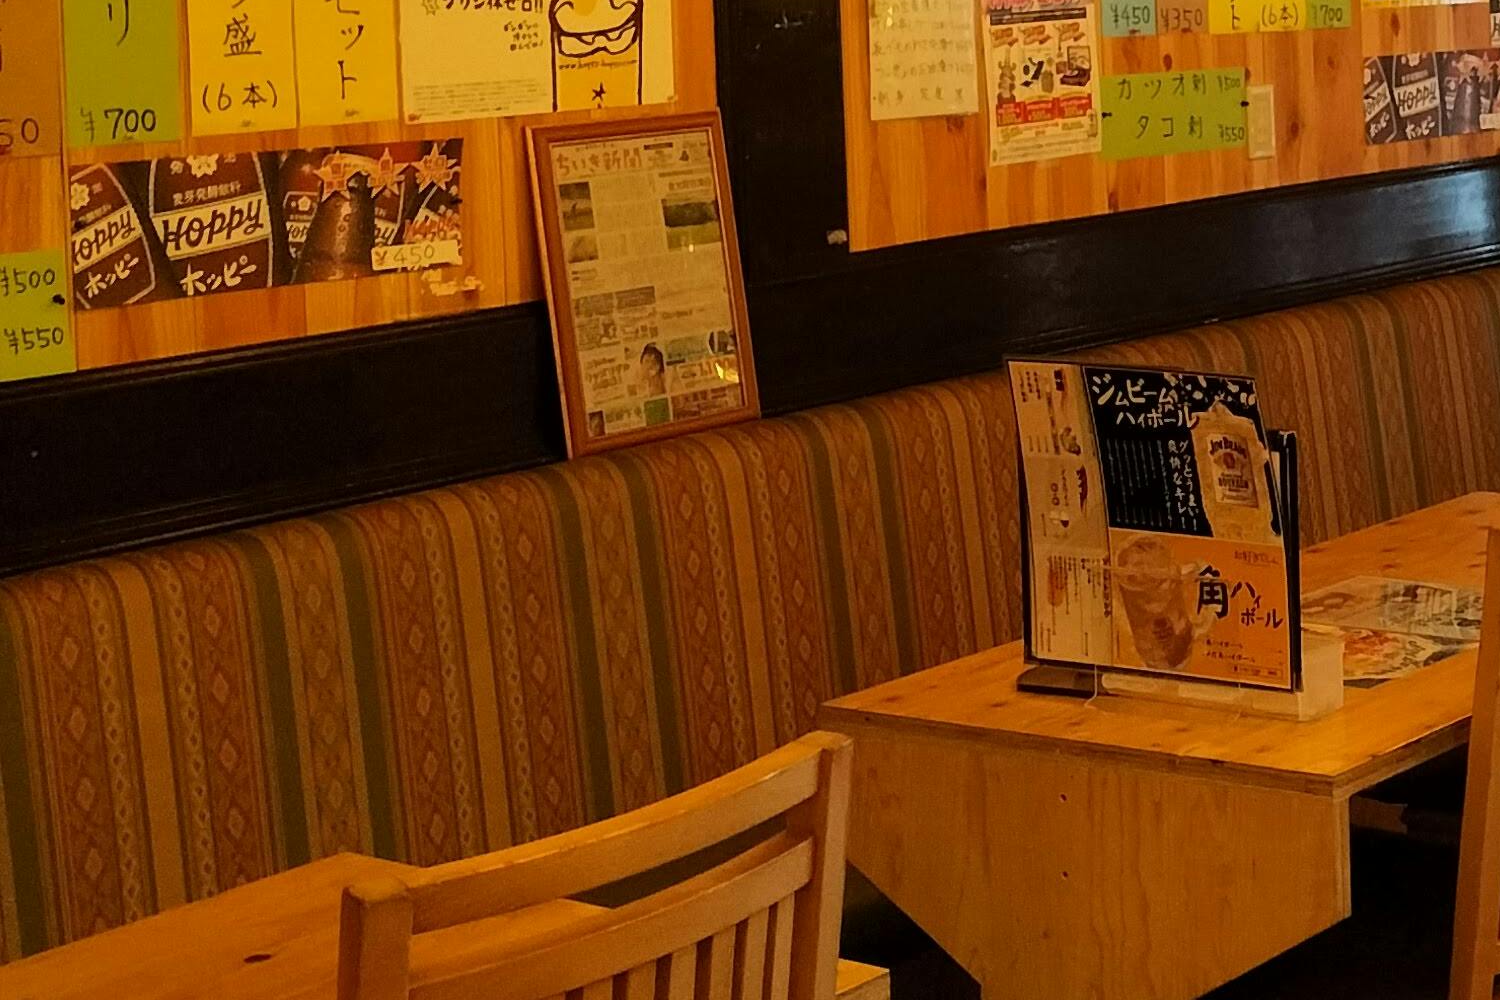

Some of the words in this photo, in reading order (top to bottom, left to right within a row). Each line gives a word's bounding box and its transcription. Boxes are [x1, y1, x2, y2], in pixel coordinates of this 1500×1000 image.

[1110, 3, 1151, 26] ¥450
[1160, 6, 1203, 31] ¥350
[201, 82, 278, 114] (6本)
[81, 108, 157, 138] ¥700
[1135, 114, 1203, 140] タコ刺
[1218, 124, 1245, 144] ¥550
[162, 200, 264, 251] Hoppy
[375, 244, 434, 265] ¥450
[85, 254, 139, 298] ホッピー
[180, 255, 258, 295] ホッピー
[4, 327, 64, 354] ¥550
[1092, 373, 1178, 405] ジムビーム
[1116, 406, 1198, 429] ハイボール
